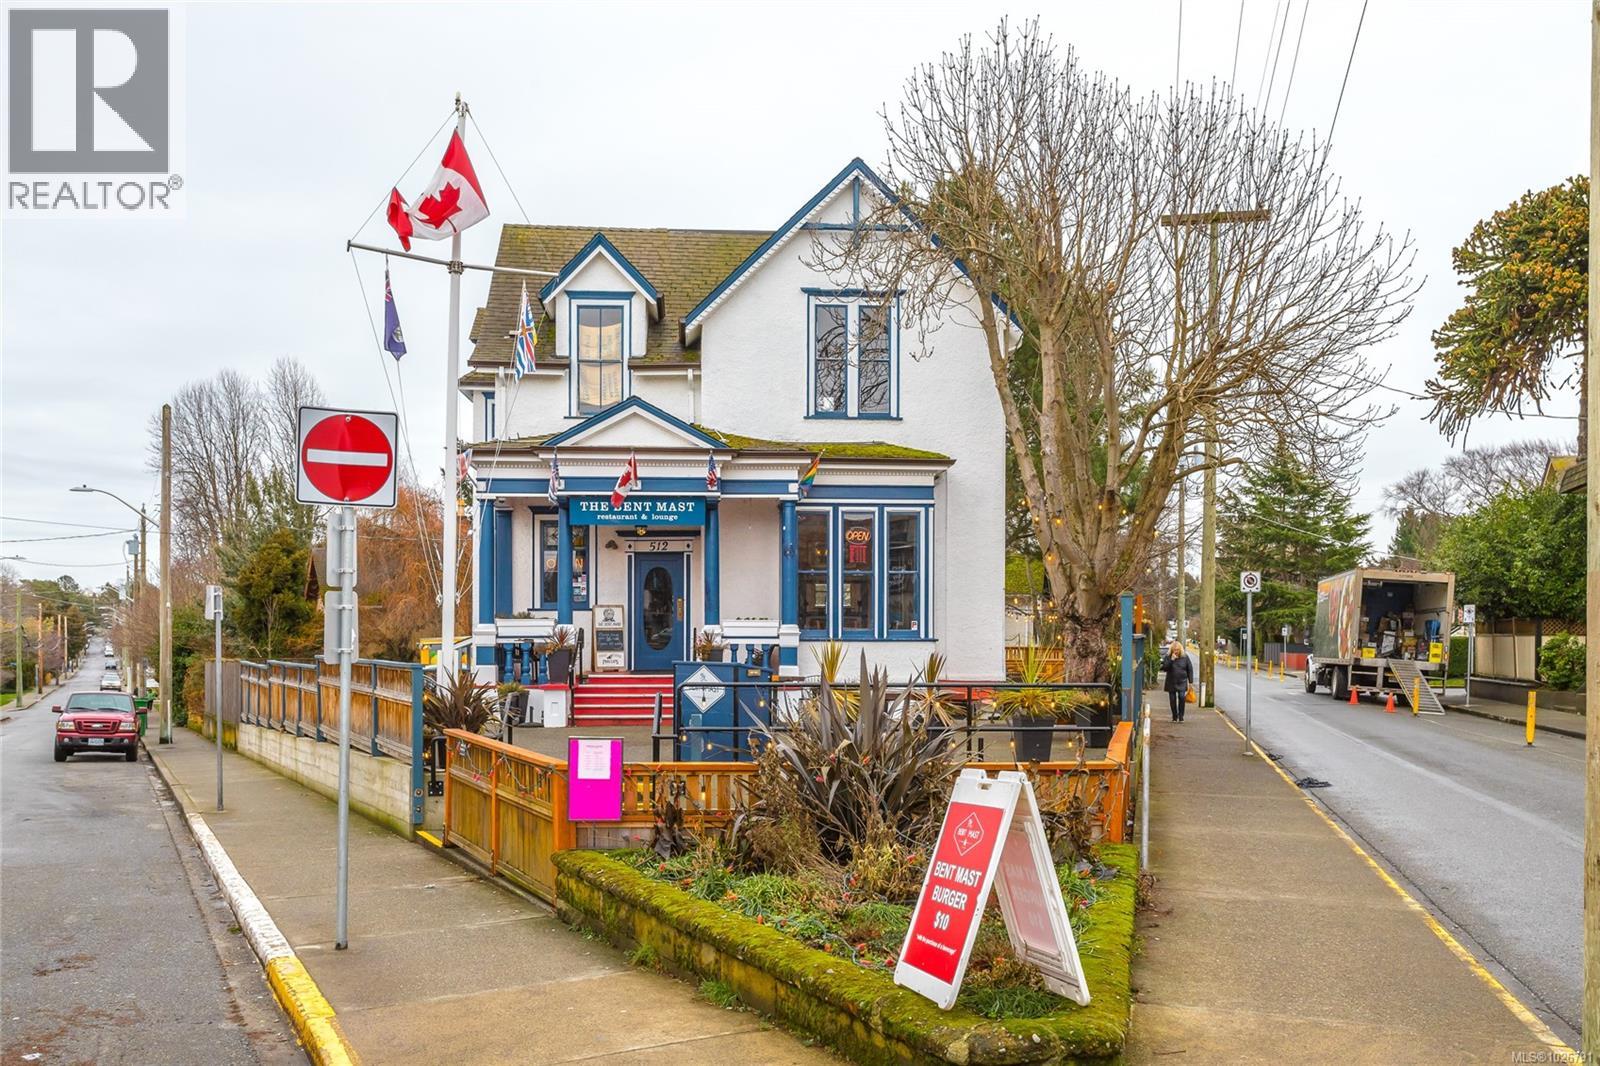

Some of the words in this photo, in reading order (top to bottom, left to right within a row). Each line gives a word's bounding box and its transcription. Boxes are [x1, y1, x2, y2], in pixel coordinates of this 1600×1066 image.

[580, 501, 609, 511] THE
[656, 501, 696, 511] MAST
[651, 513, 679, 521] lounge
[846, 529, 870, 542] OPEN
[649, 541, 669, 551] 512
[934, 861, 957, 880] BENT
[955, 865, 982, 888] MAST
[931, 885, 968, 911] BURGER
[933, 910, 950, 931] $10
